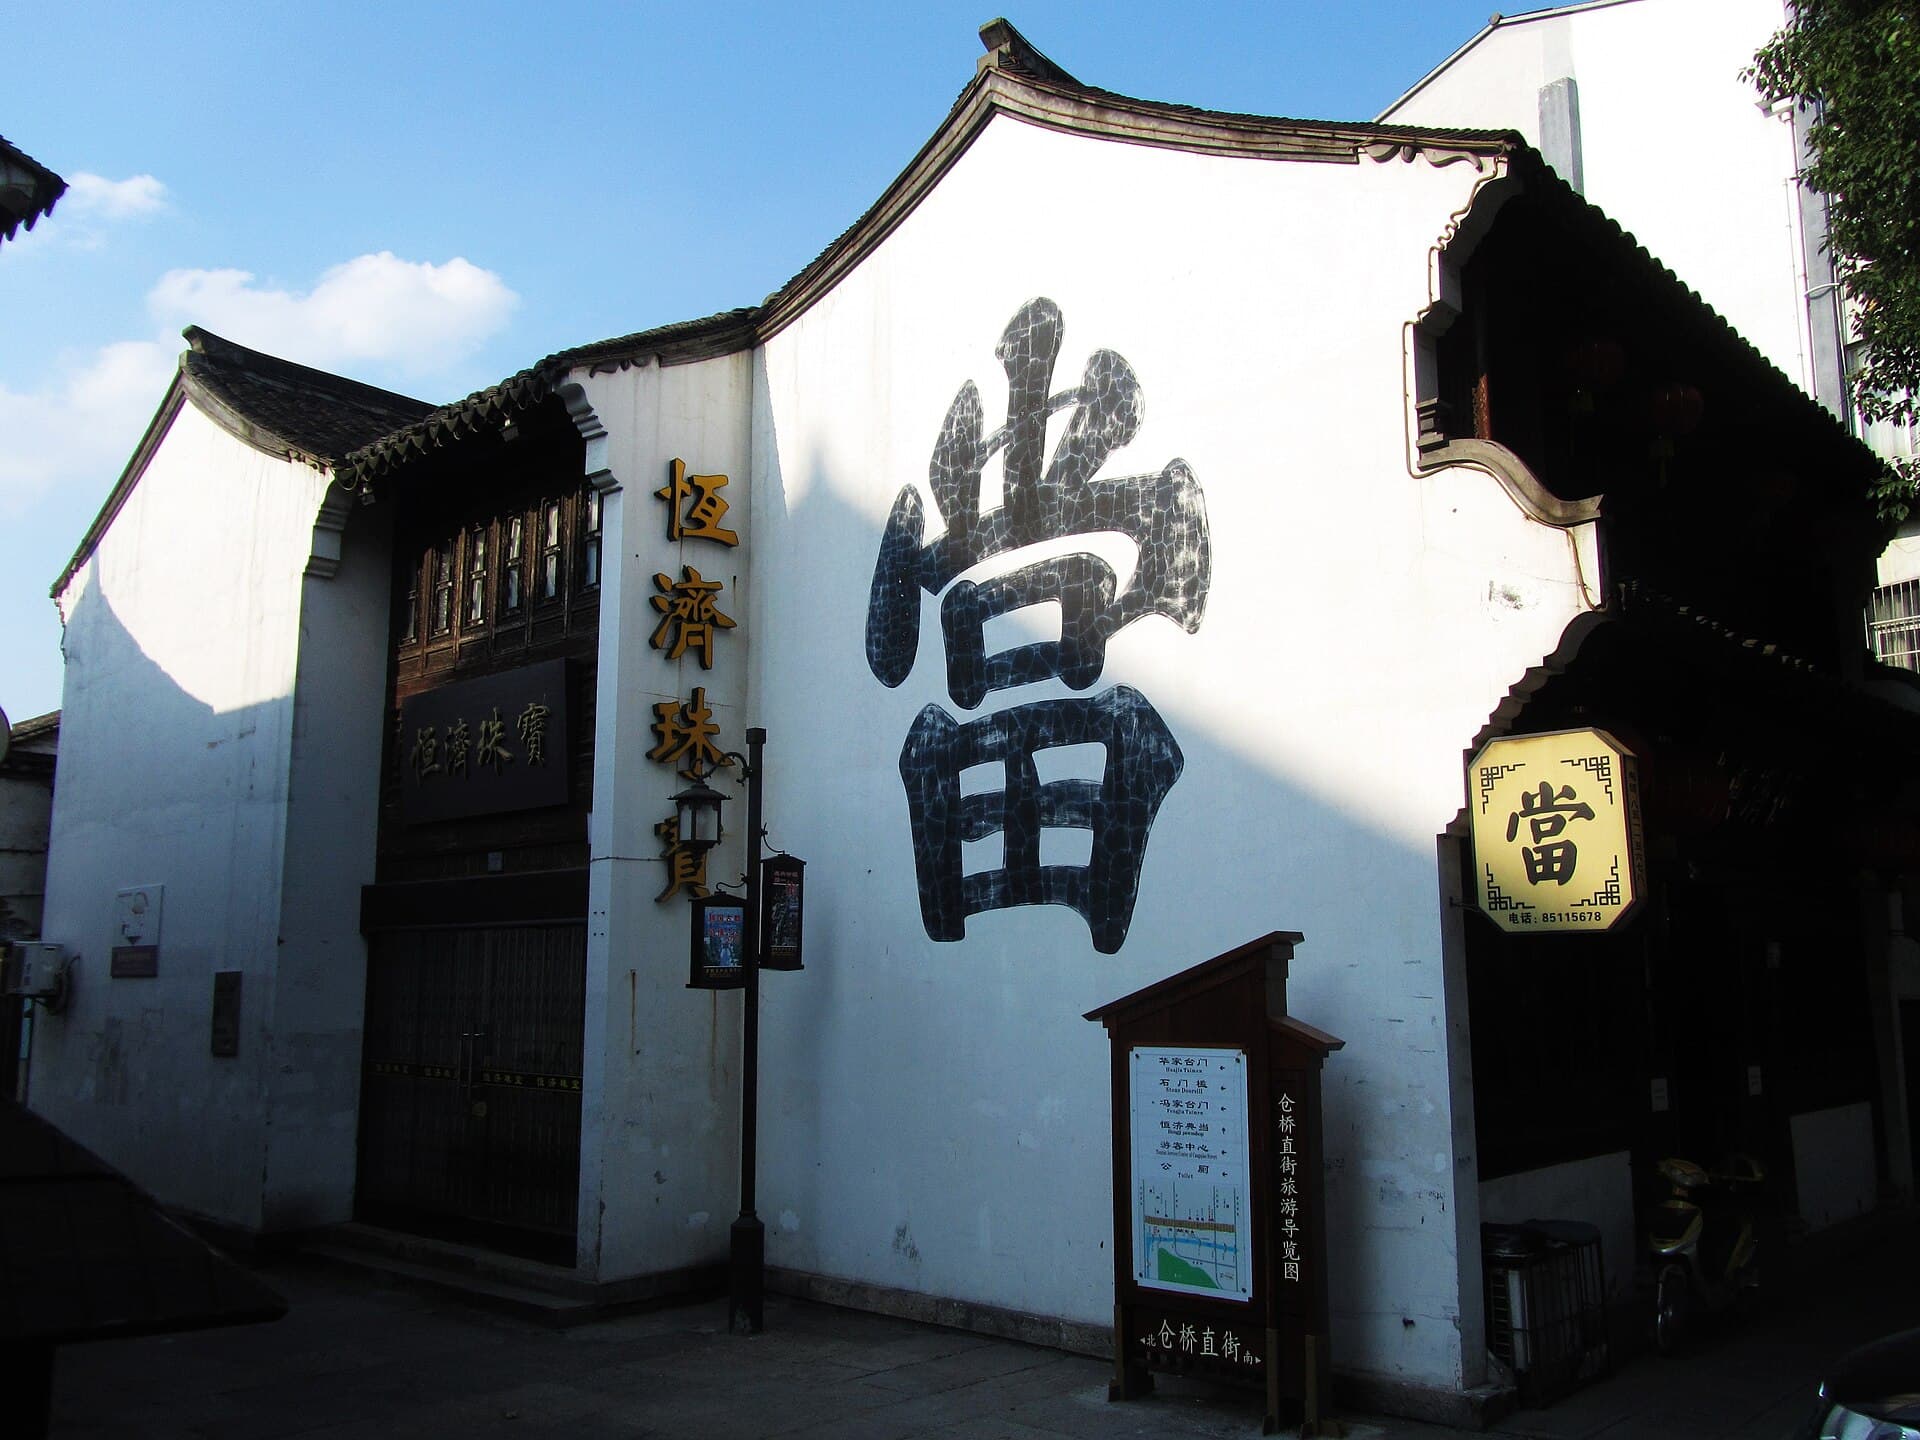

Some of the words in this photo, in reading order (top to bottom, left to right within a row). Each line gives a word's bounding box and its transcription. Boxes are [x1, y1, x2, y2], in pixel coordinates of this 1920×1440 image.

[865, 297, 1211, 955] 當
[1506, 781, 1596, 886] 當
[1160, 1140, 1209, 1152] 游客中心
[1278, 1092, 1300, 1283] 仓桥直街旅游导览图
[1146, 1334, 1157, 1347] 北
[1158, 1317, 1241, 1363] 仓桥直街
[1243, 1350, 1253, 1365] 南
